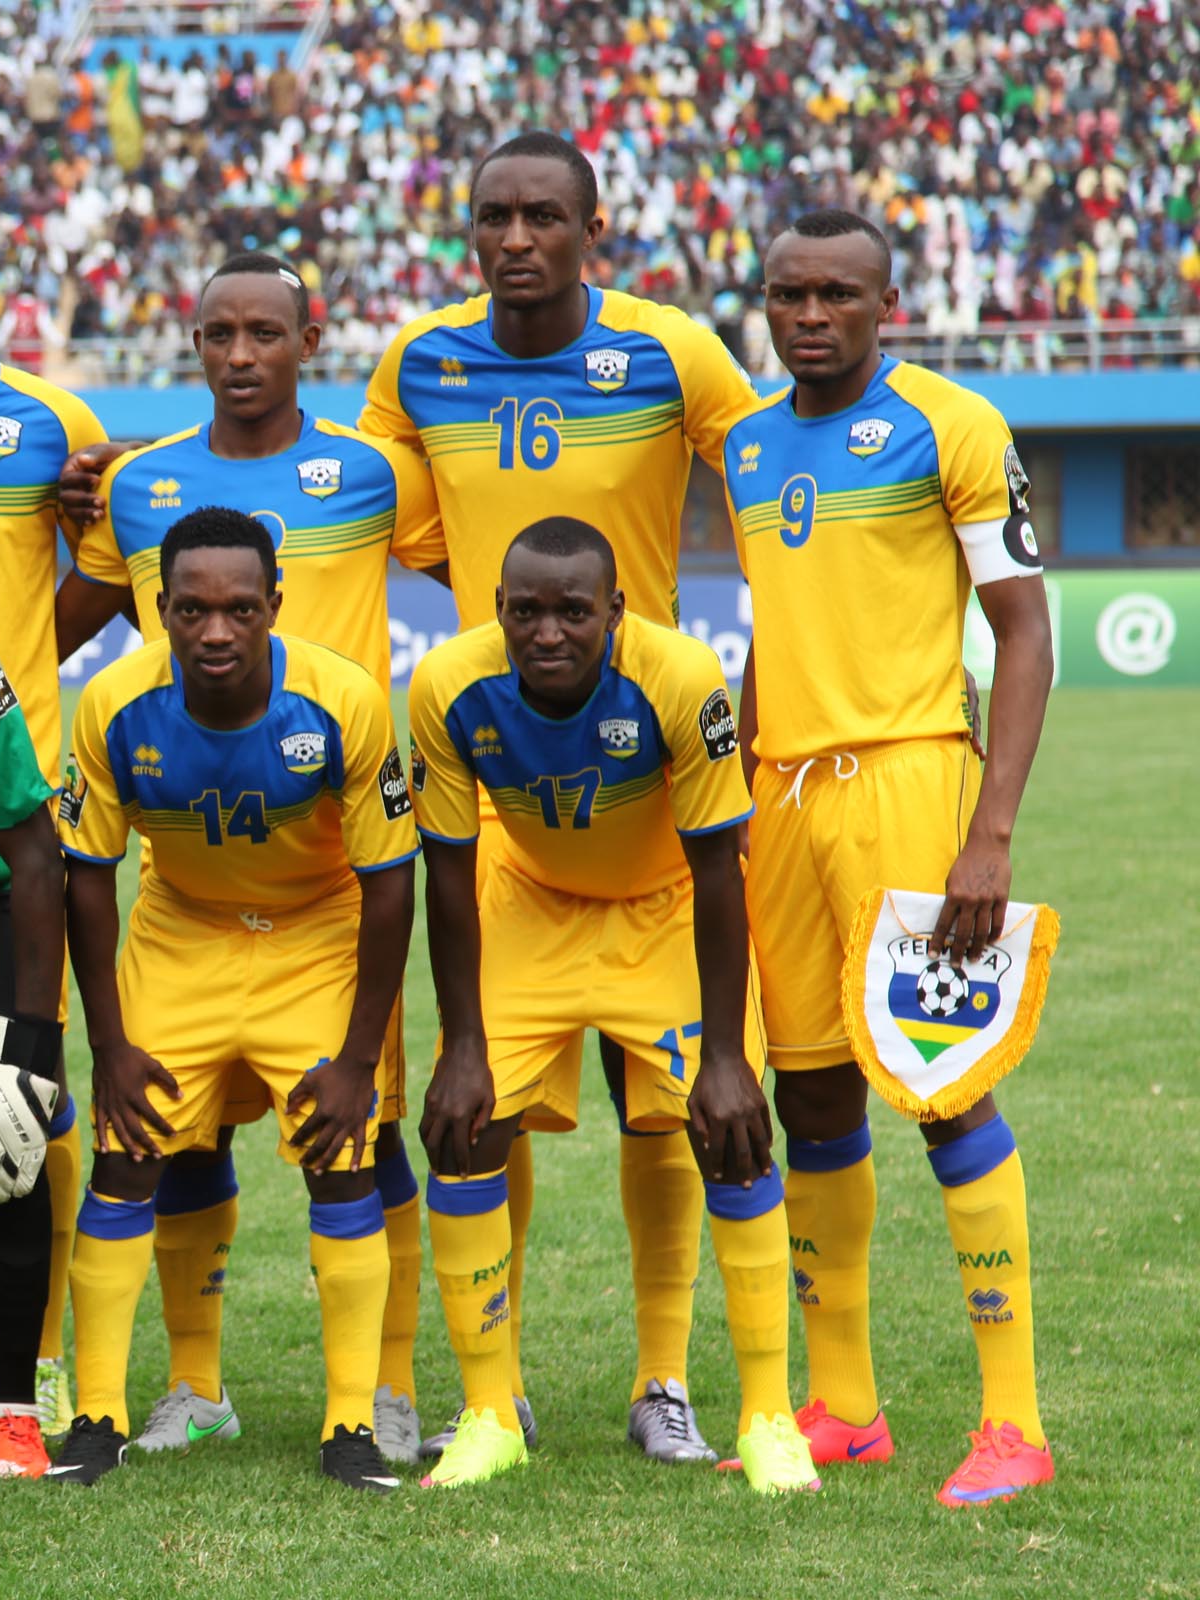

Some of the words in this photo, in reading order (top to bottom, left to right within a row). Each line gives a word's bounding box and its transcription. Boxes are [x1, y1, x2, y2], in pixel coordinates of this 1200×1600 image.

[490, 397, 563, 471] 16
[779, 473, 818, 548] 9
[283, 733, 323, 746] FERWAFA
[189, 788, 272, 847] 14
[525, 766, 603, 830] 17
[789, 1236, 819, 1257] WA
[958, 1249, 1013, 1270] RWA
